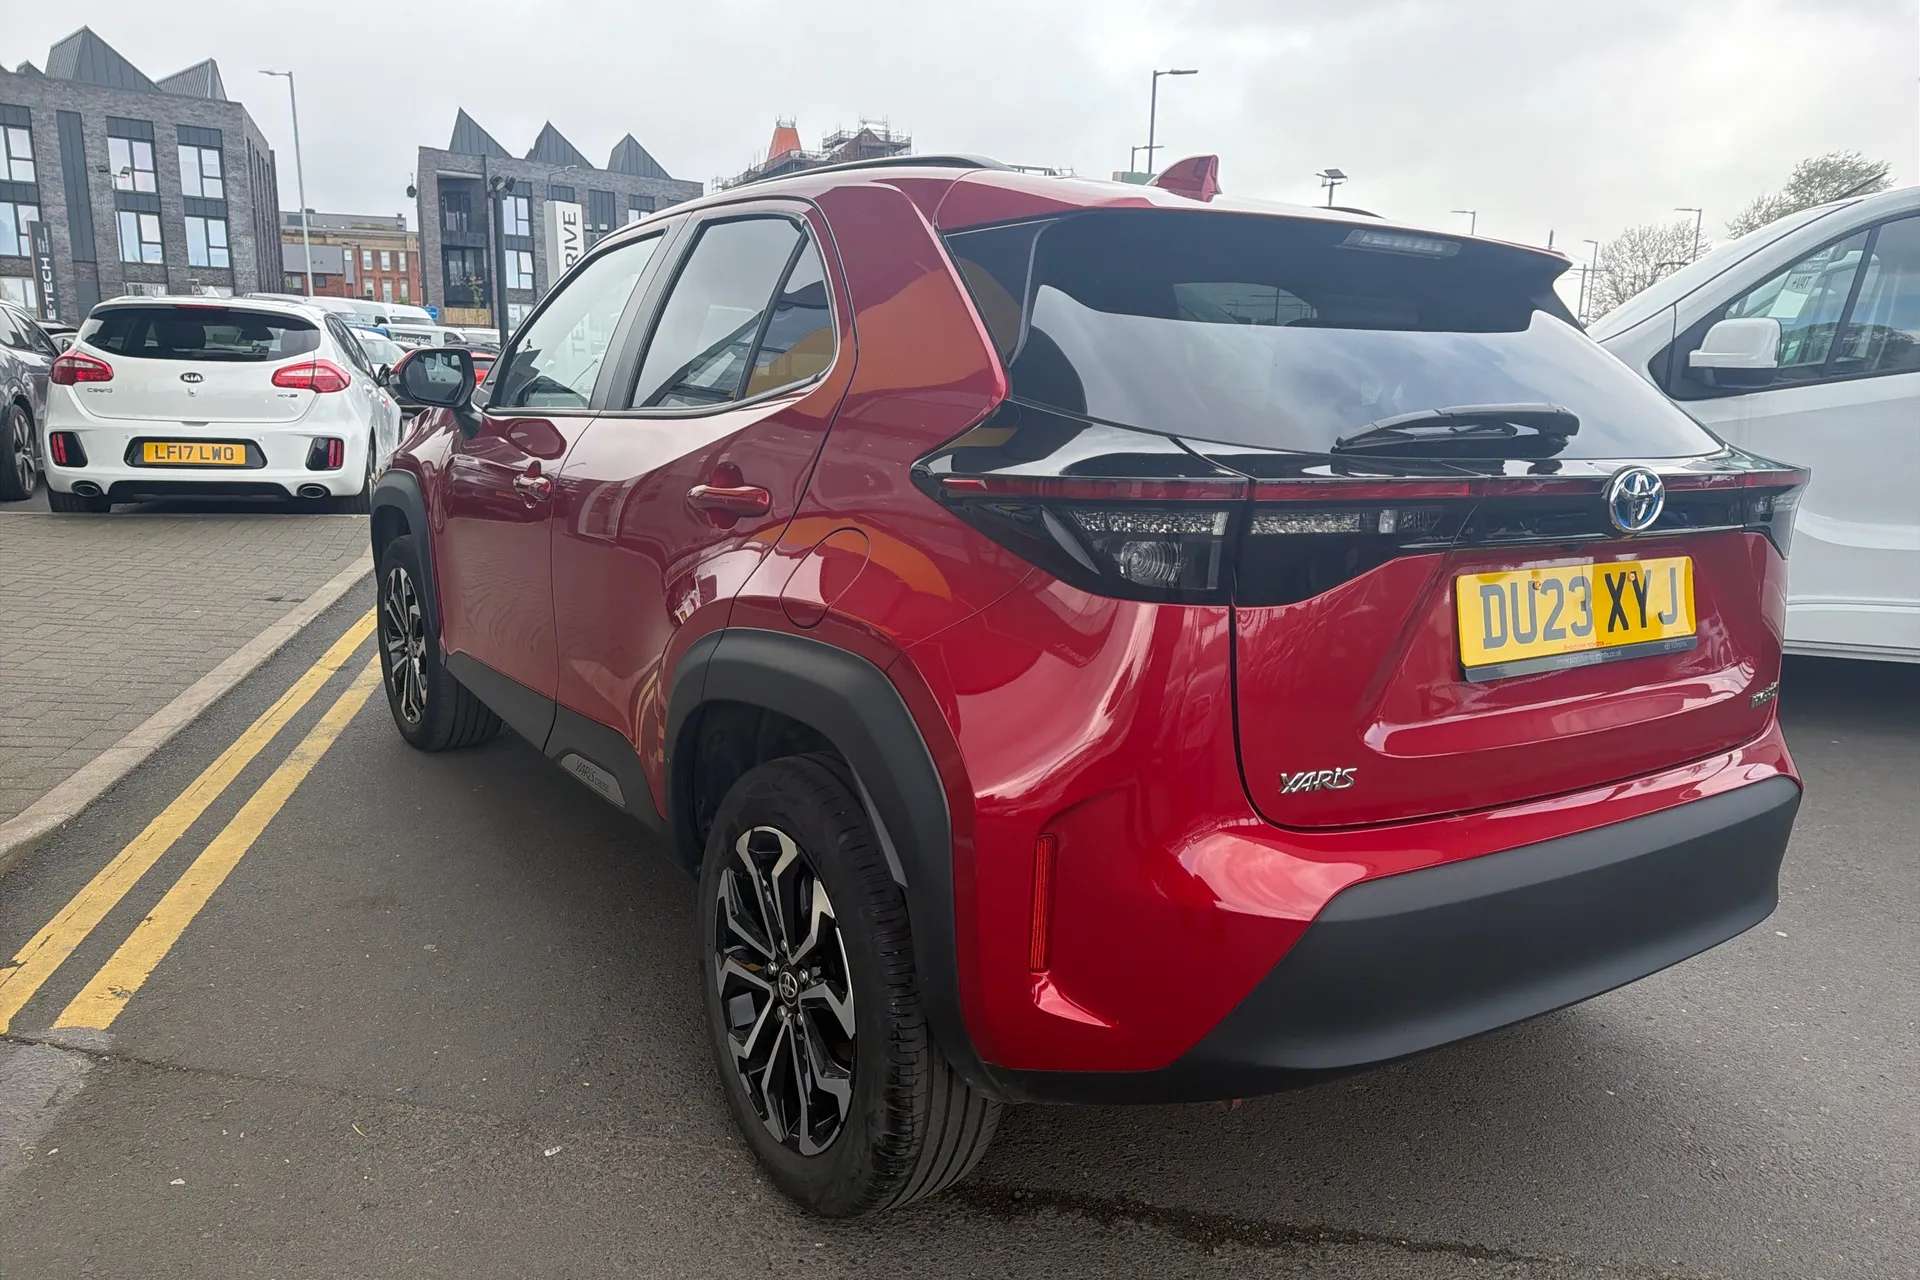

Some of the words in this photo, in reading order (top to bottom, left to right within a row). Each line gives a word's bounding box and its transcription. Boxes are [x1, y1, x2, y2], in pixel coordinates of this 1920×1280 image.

[562, 210, 579, 268] RIVE
[182, 373, 202, 382] KIA
[154, 444, 194, 460] LF17
[199, 445, 235, 461] LWO
[1479, 575, 1594, 650] DU23
[1603, 566, 1678, 633] XYJ
[1279, 766, 1358, 794] YARIS
